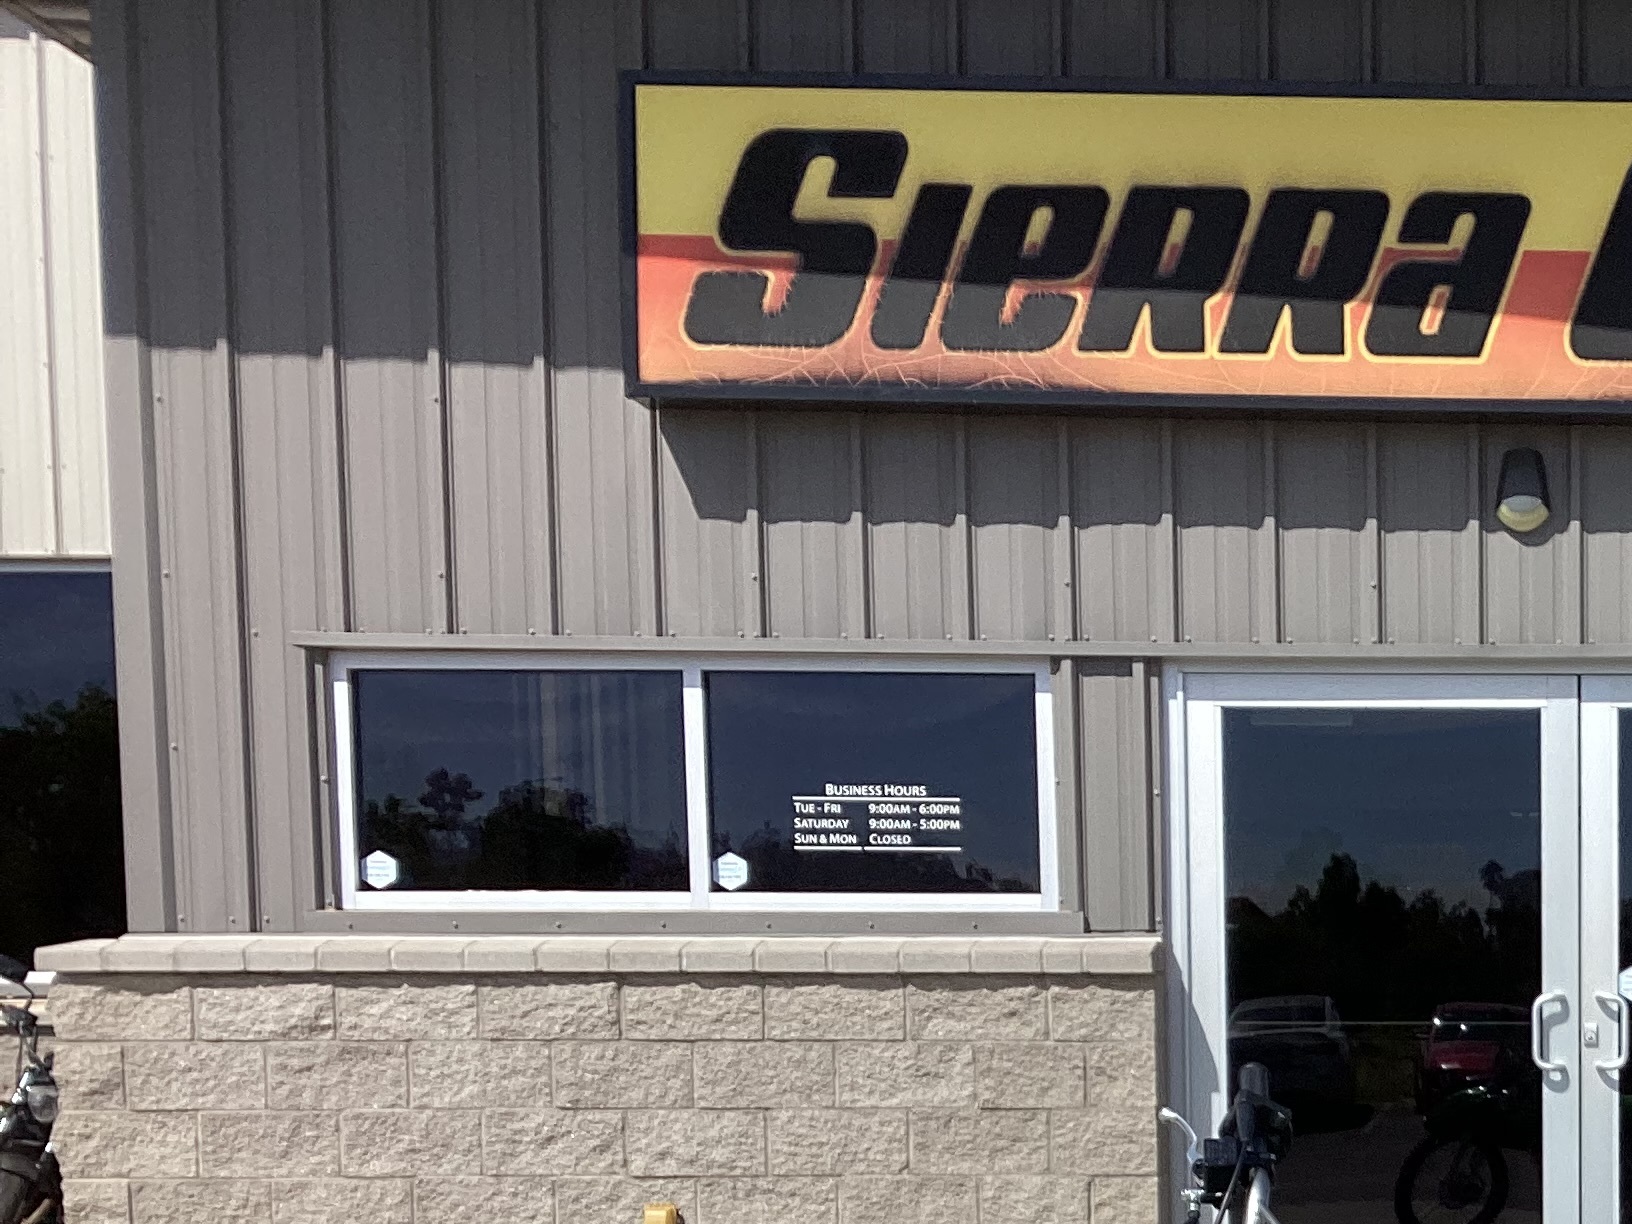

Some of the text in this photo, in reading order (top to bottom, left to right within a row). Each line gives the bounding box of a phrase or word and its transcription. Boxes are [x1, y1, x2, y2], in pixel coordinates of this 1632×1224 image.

[825, 783, 927, 796] BUSINESS HOURS
[794, 802, 816, 813] TUE
[823, 802, 842, 813] FRI
[868, 803, 911, 814] 9:00AM
[919, 803, 960, 814] 6:00PM
[794, 817, 849, 829] SATURDAY
[868, 818, 911, 829] 9:00AM
[919, 818, 960, 830] 5:00PM
[794, 832, 911, 845] SUN & MON CLOSED
